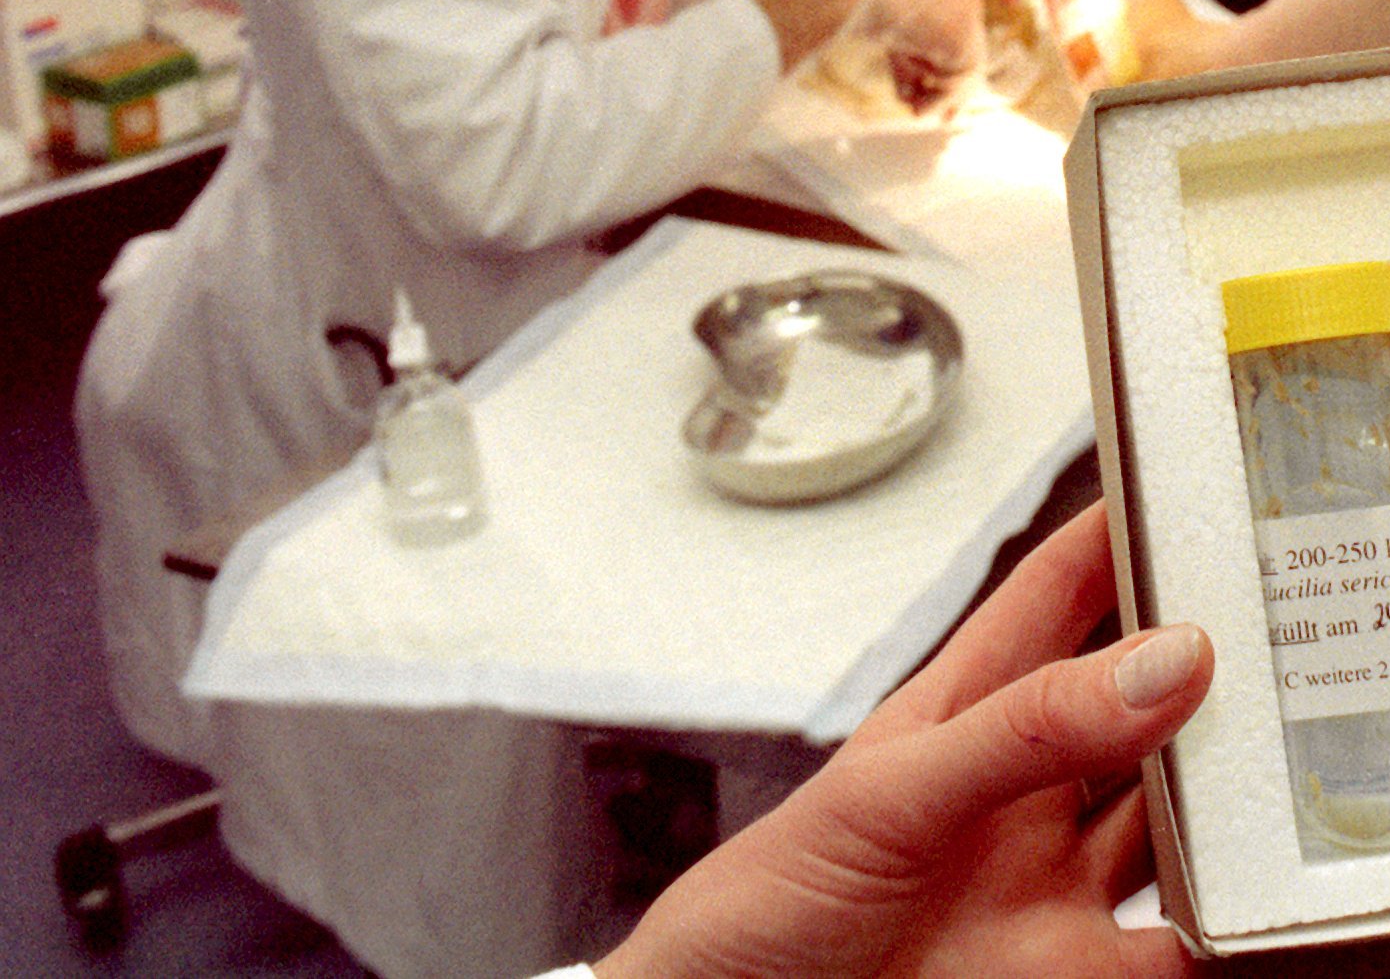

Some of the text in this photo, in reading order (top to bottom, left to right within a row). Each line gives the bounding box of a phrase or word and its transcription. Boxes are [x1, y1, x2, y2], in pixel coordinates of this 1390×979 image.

[1286, 541, 1377, 571] 200-250
[1326, 618, 1358, 638] am
[1305, 665, 1371, 688] weitere
[1377, 660, 1388, 678] 2
